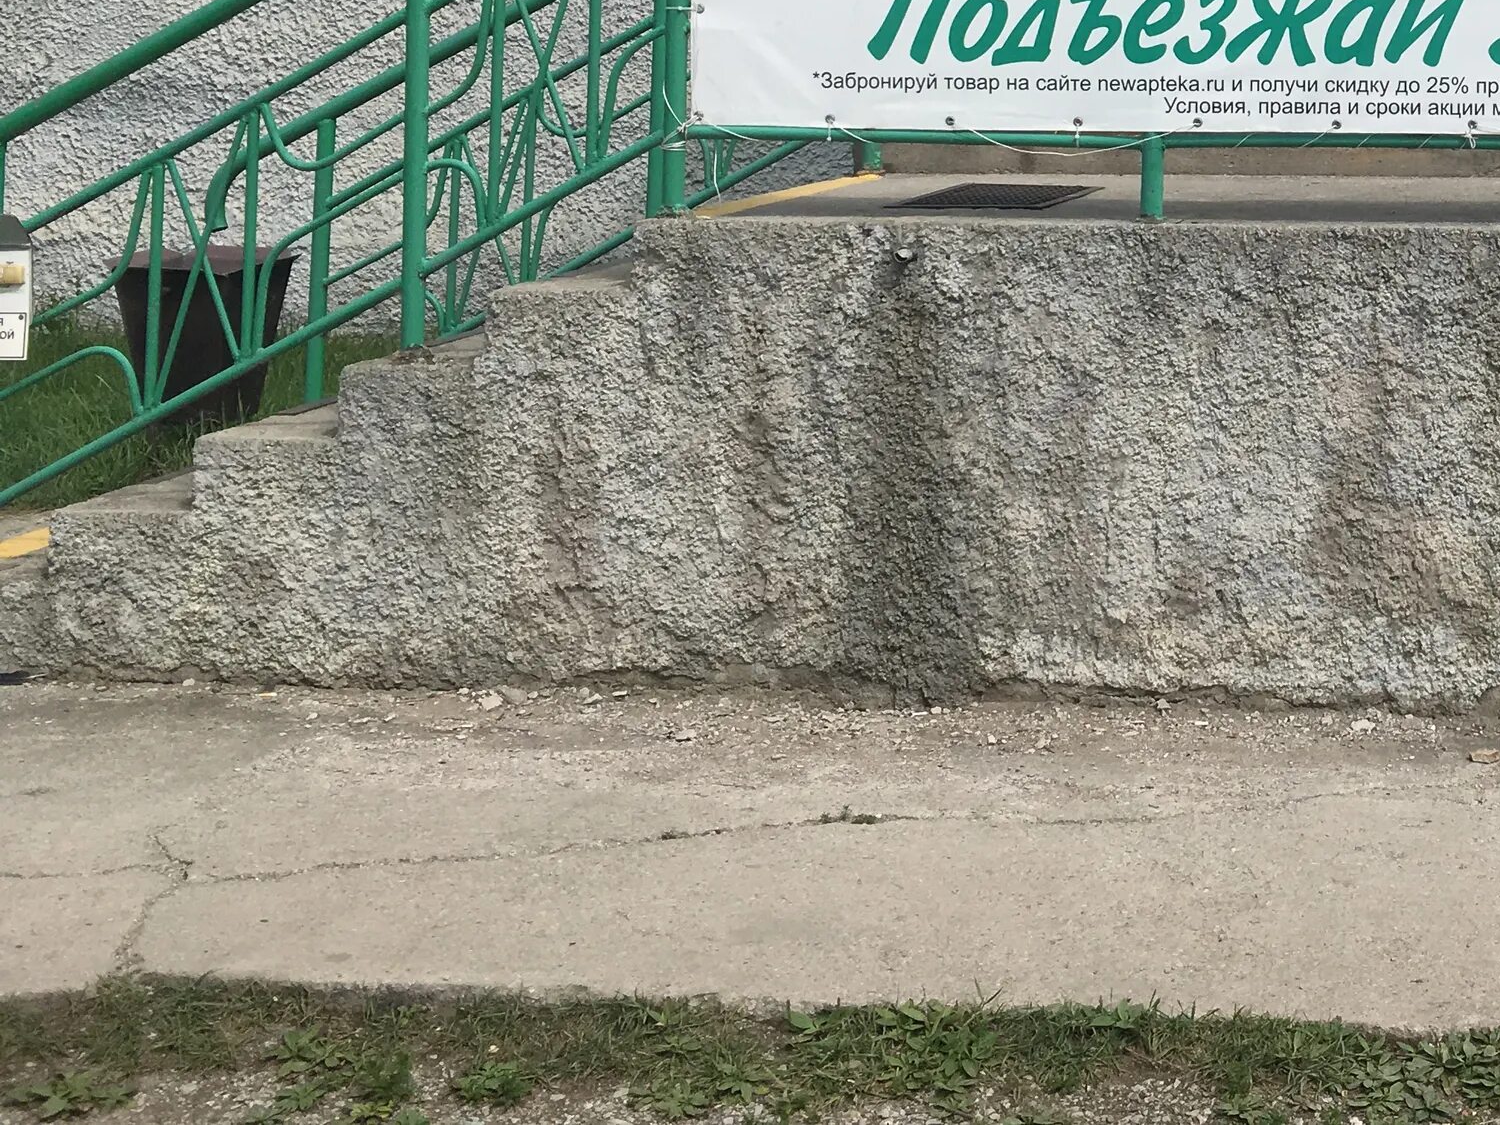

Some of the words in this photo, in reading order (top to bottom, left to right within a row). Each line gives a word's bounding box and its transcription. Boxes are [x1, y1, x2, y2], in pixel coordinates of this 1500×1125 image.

[943, 77, 1000, 92] товар
[1006, 78, 1030, 91] на
[1035, 74, 1092, 92] сайте
[1097, 75, 1225, 95] newapteka.ru
[1231, 79, 1243, 92] и
[1249, 79, 1318, 96] получи
[1324, 79, 1391, 96] скидку
[1395, 80, 1421, 97] до
[1426, 76, 1469, 94] 25%
[1163, 96, 1251, 115] Условия,
[1258, 100, 1342, 117] правила
[1347, 102, 1359, 115] и
[1365, 102, 1422, 118] сроки
[1427, 102, 1486, 116] акции
